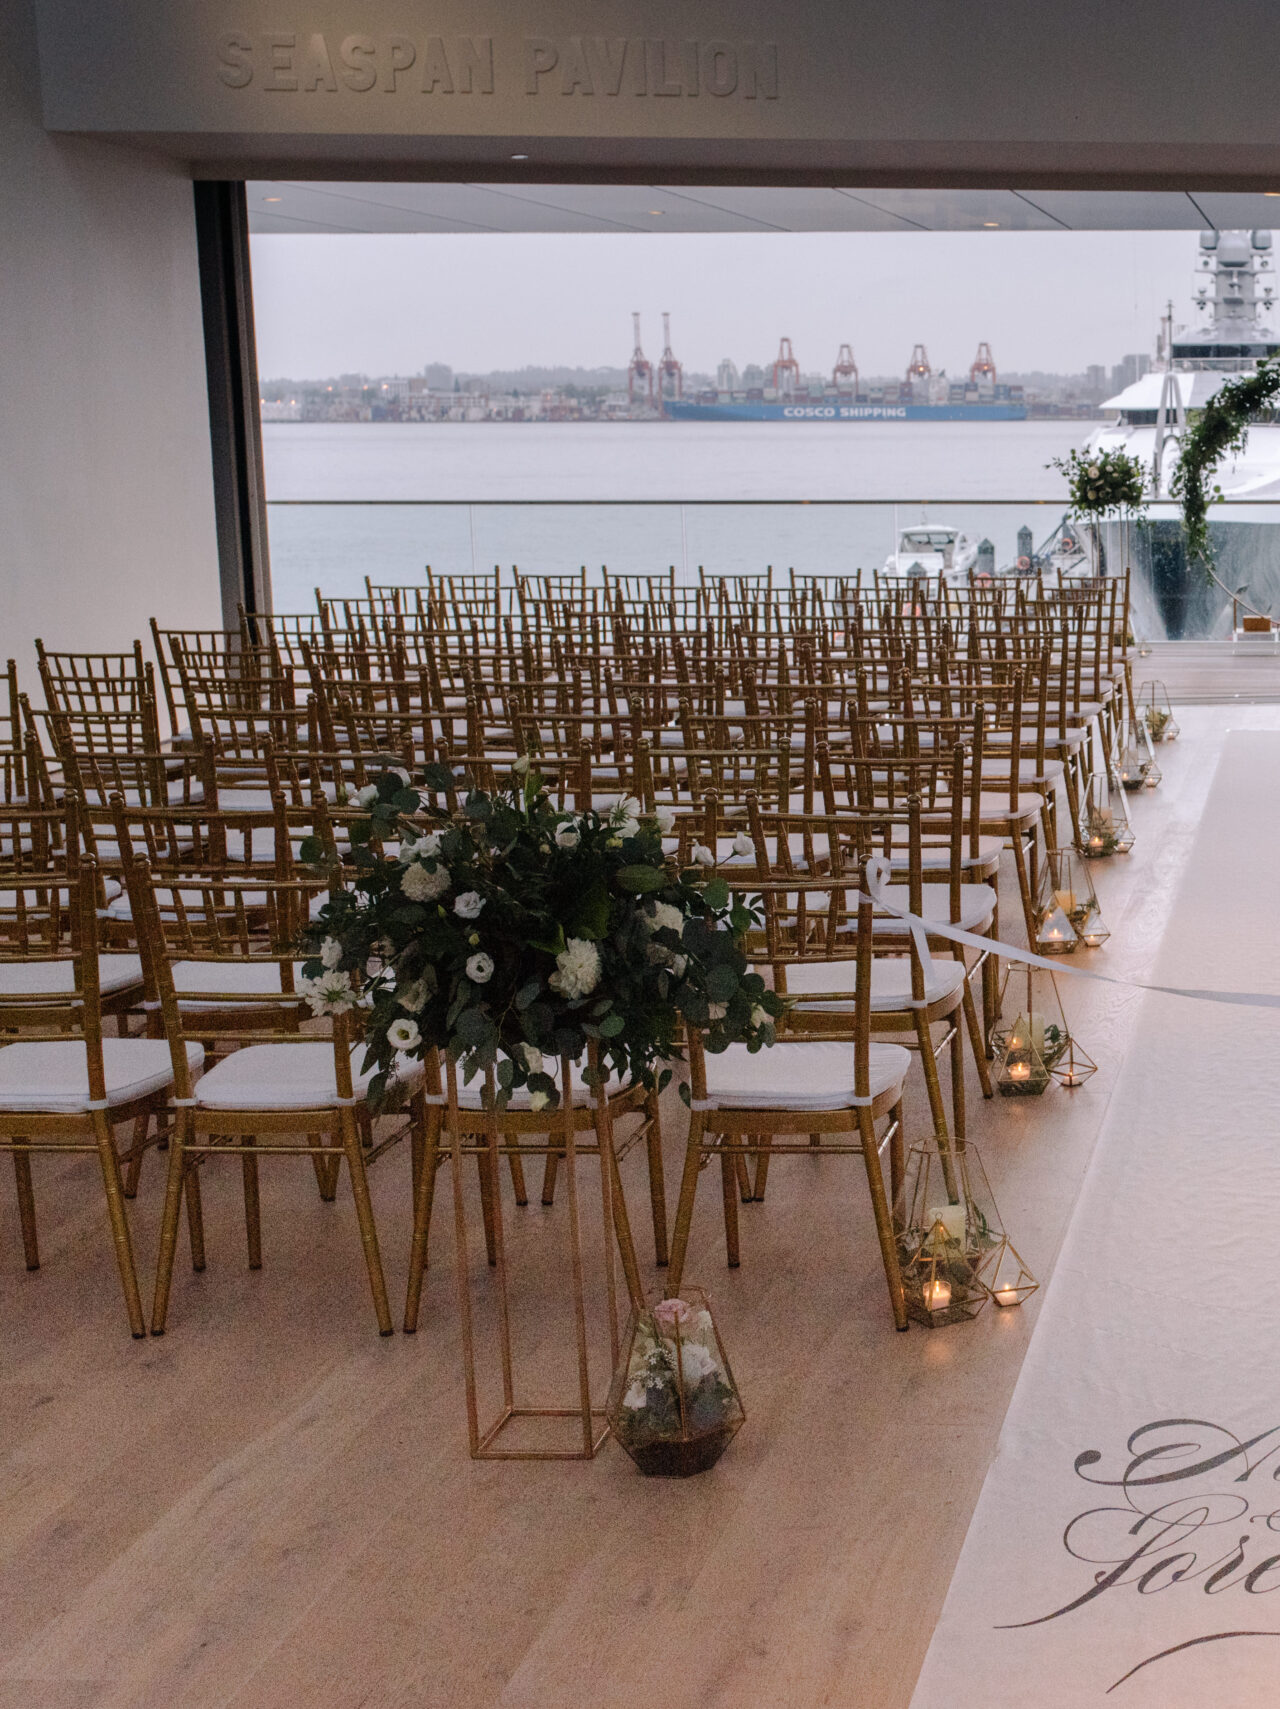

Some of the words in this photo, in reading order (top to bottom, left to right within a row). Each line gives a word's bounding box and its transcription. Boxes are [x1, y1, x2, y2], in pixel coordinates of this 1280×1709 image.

[217, 32, 496, 95] SEASPAN
[524, 37, 780, 100] PAVILION
[784, 407, 835, 417] COSCO
[840, 407, 906, 417] SHIPPING
